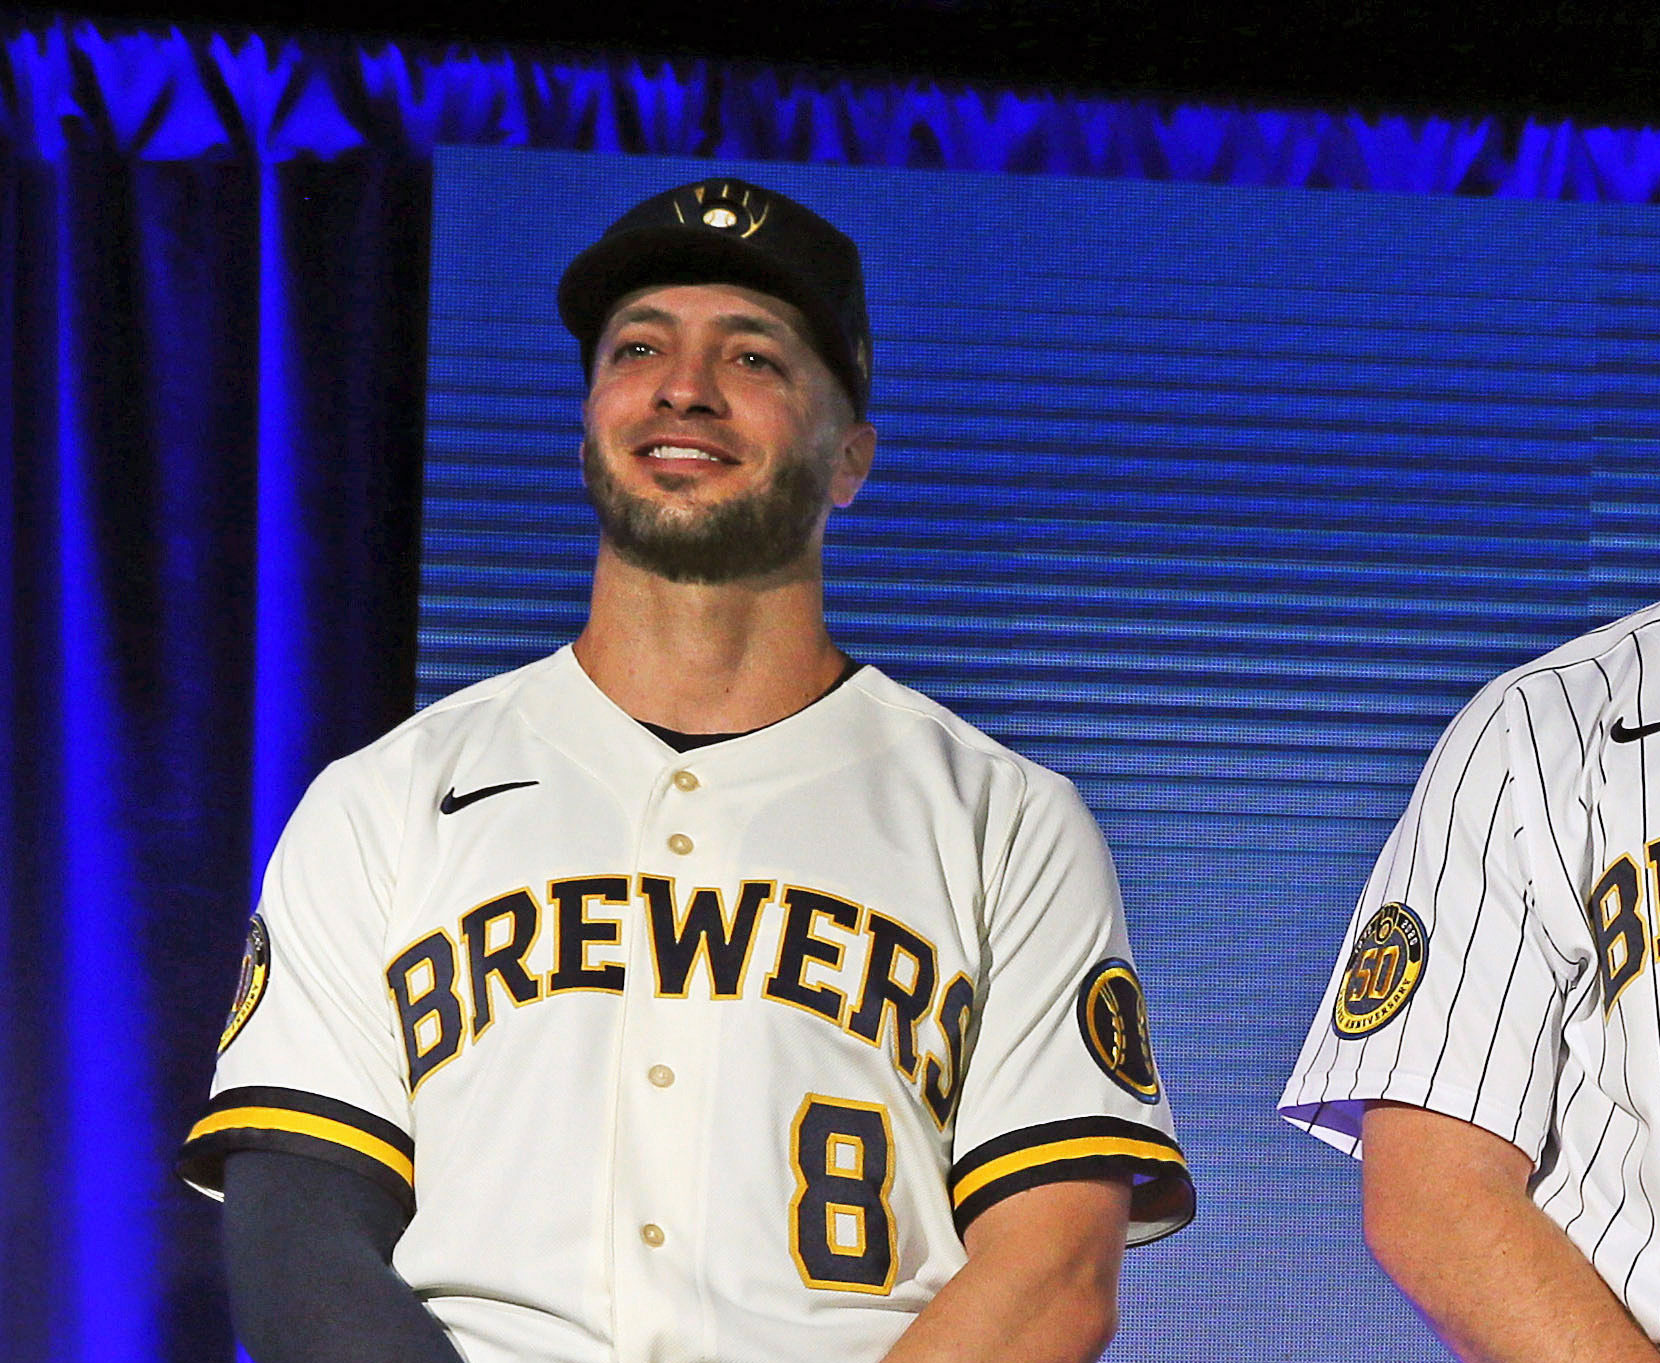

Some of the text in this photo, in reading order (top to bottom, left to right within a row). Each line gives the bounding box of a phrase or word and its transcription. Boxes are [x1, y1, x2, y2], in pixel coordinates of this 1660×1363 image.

[383, 872, 974, 1133] BREWERS
[1347, 944, 1400, 1002] 50
[788, 1091, 900, 1297] 8
